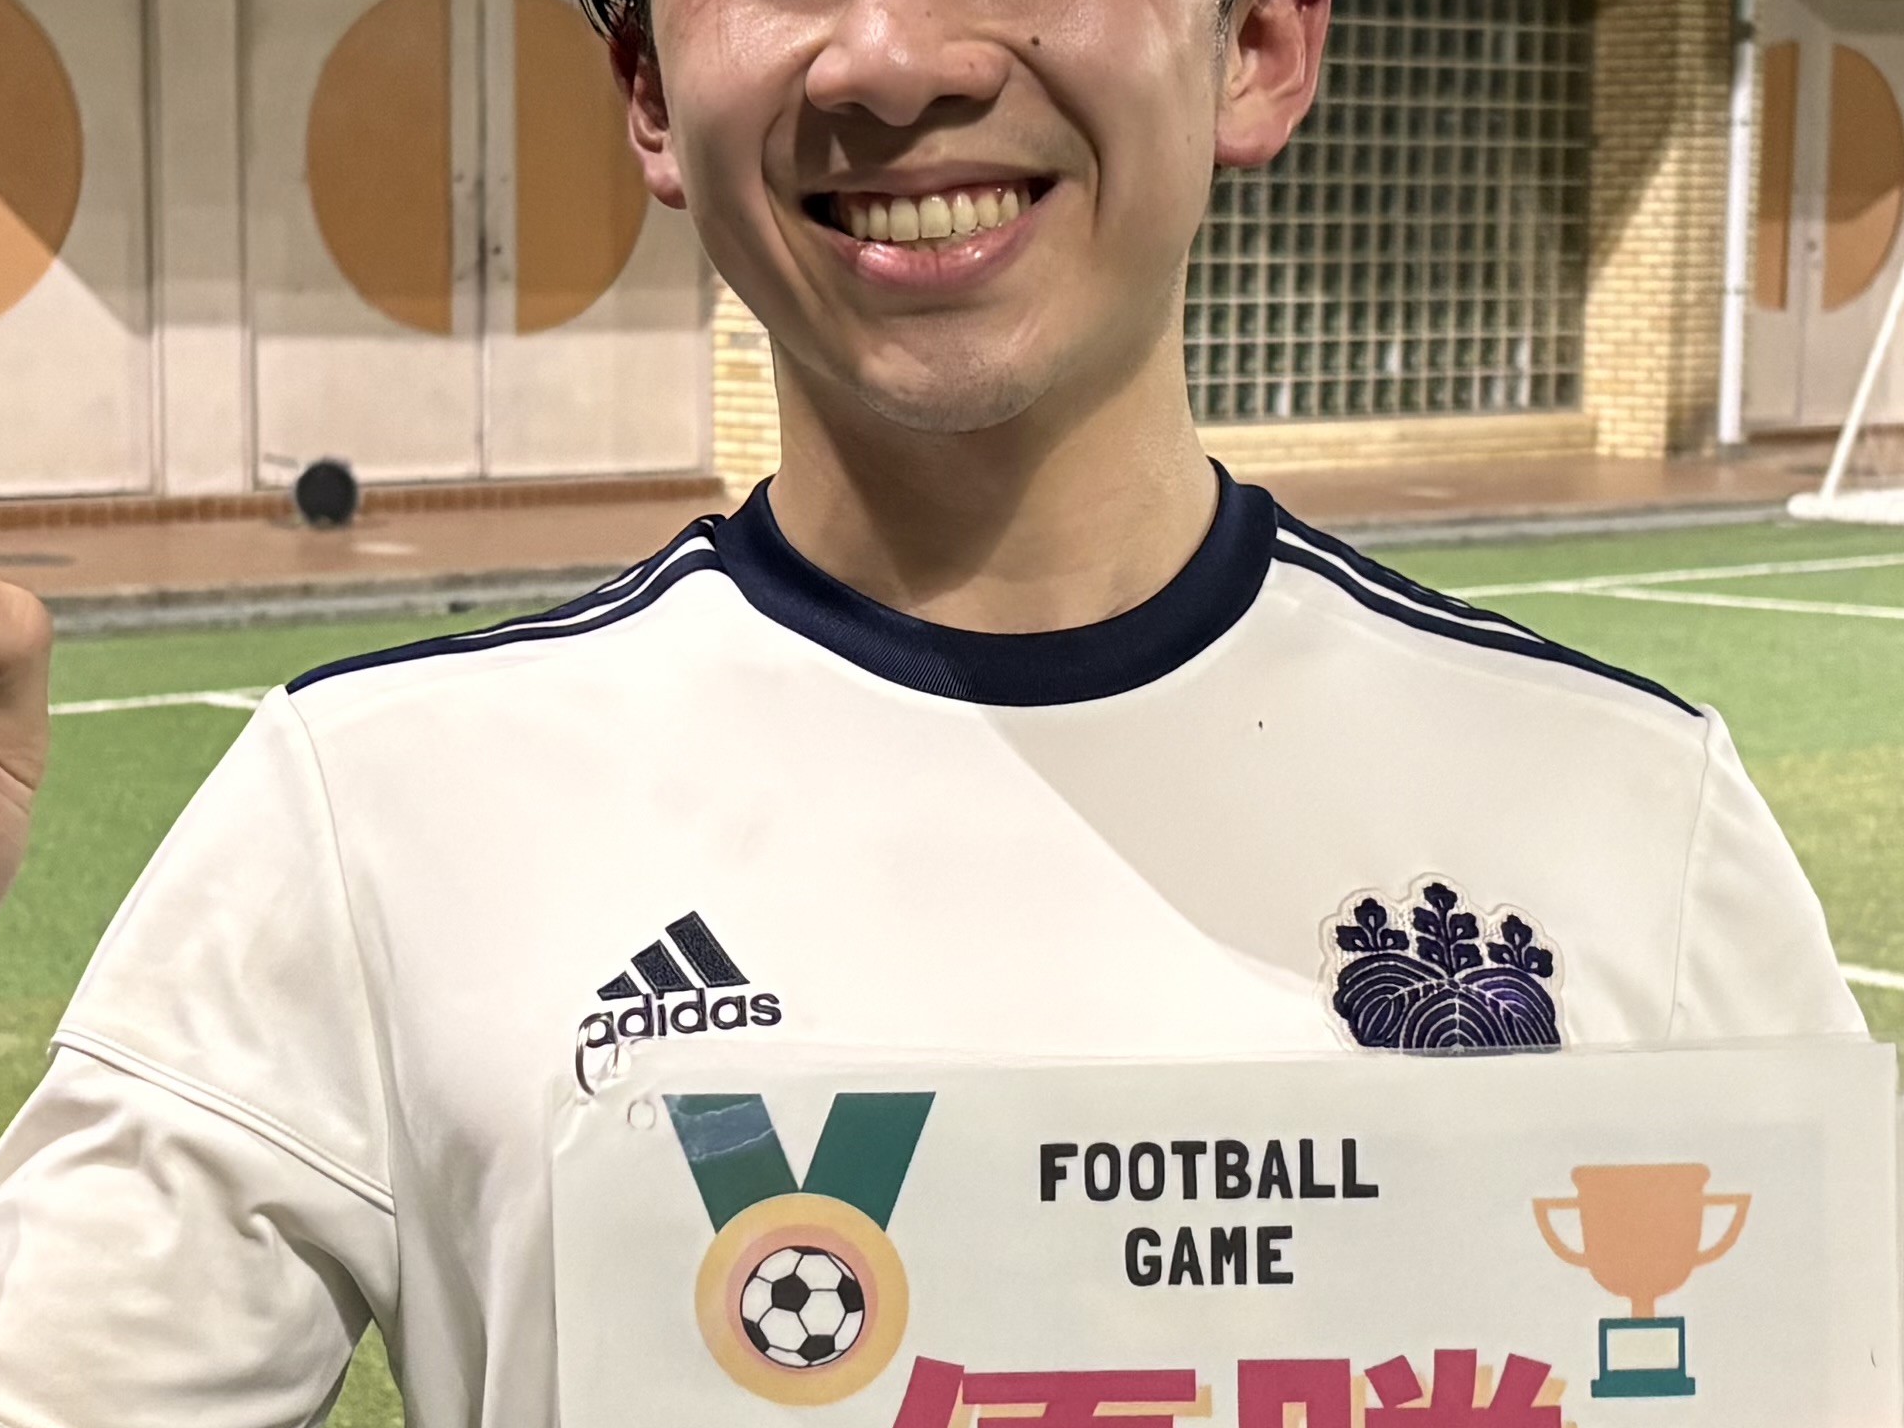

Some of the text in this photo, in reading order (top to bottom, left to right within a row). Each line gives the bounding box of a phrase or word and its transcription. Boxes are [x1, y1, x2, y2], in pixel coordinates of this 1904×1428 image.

[580, 987, 783, 1049] adidas
[1039, 1137, 1380, 1203] FOOTBALL
[1124, 1225, 1295, 1288] GAME
